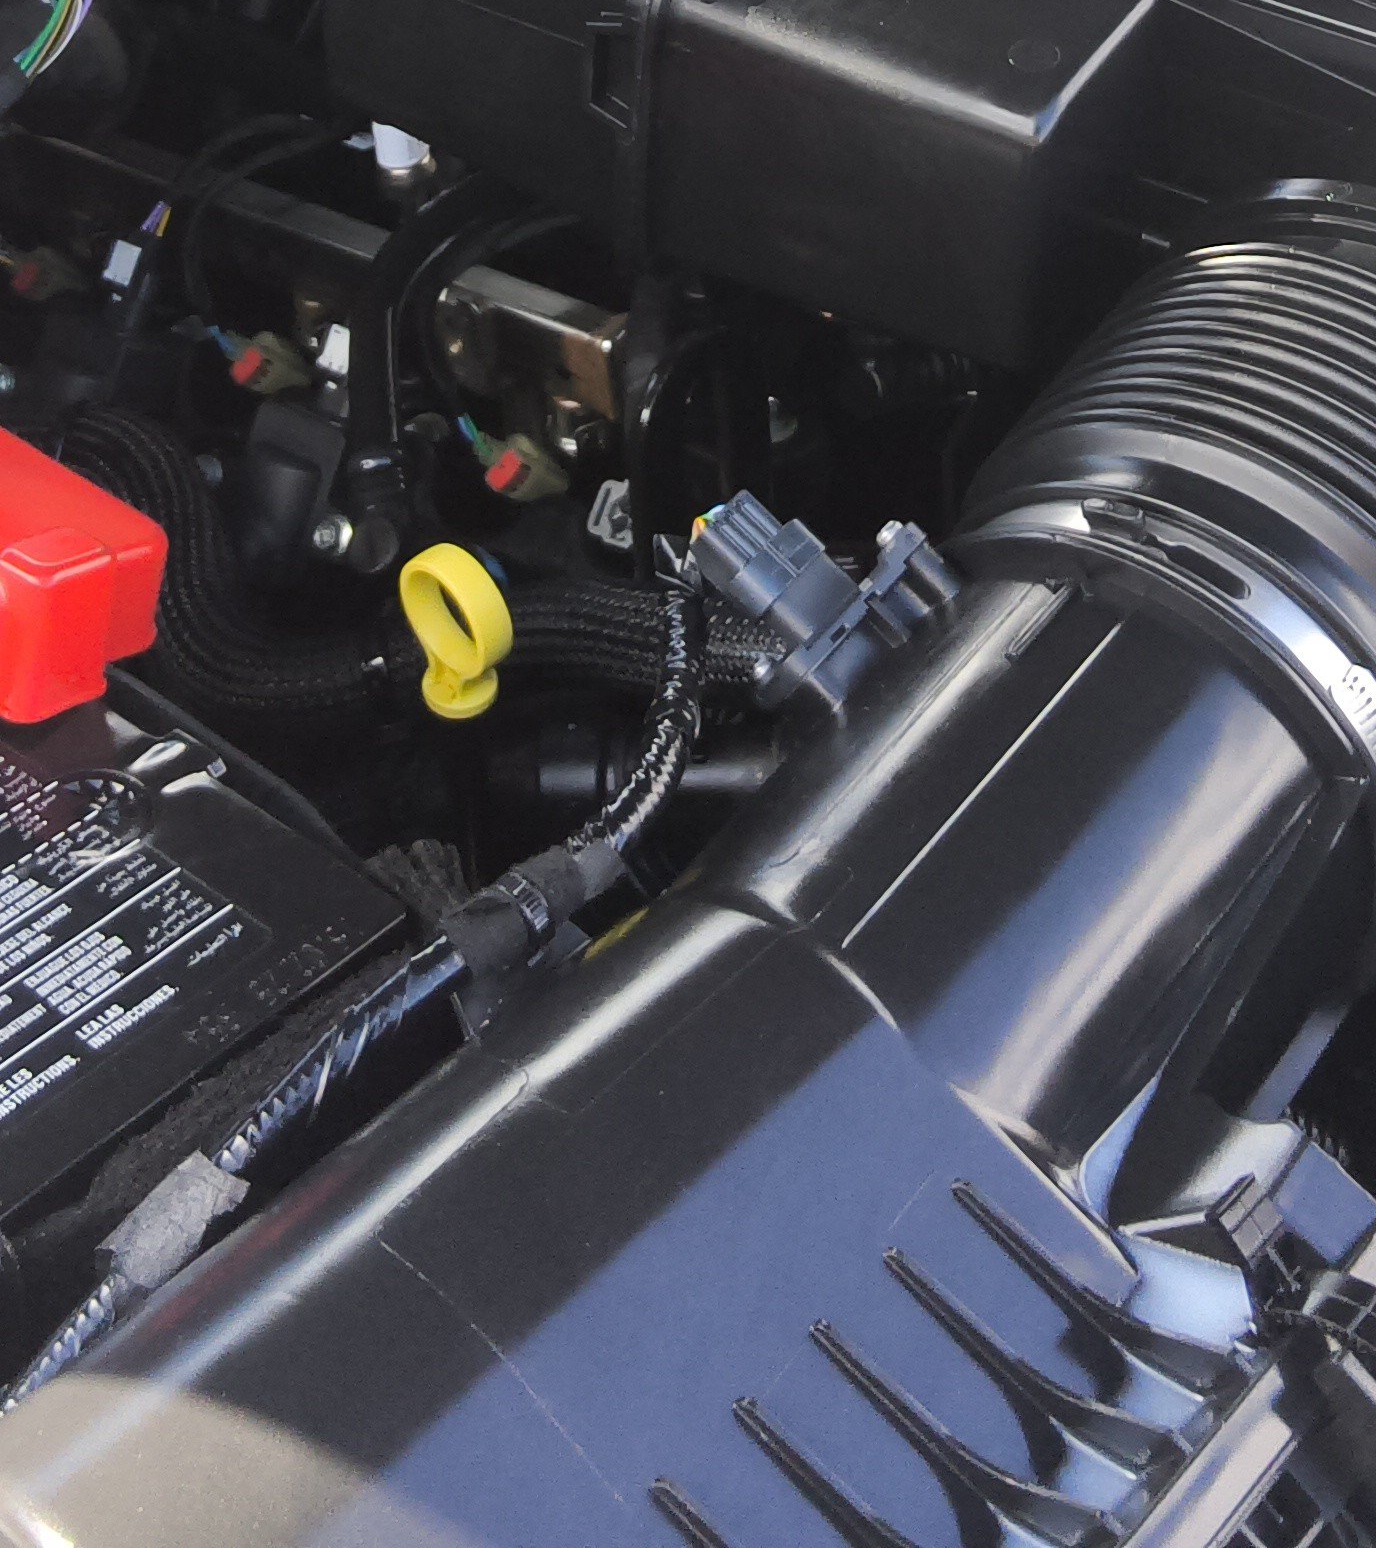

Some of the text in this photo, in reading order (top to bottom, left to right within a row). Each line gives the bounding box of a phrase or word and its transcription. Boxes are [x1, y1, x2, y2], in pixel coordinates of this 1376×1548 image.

[75, 1004, 129, 1040] LEA LAS
[87, 985, 179, 1049] INSTRUCCIONES.
[5, 1069, 34, 1089] LES
